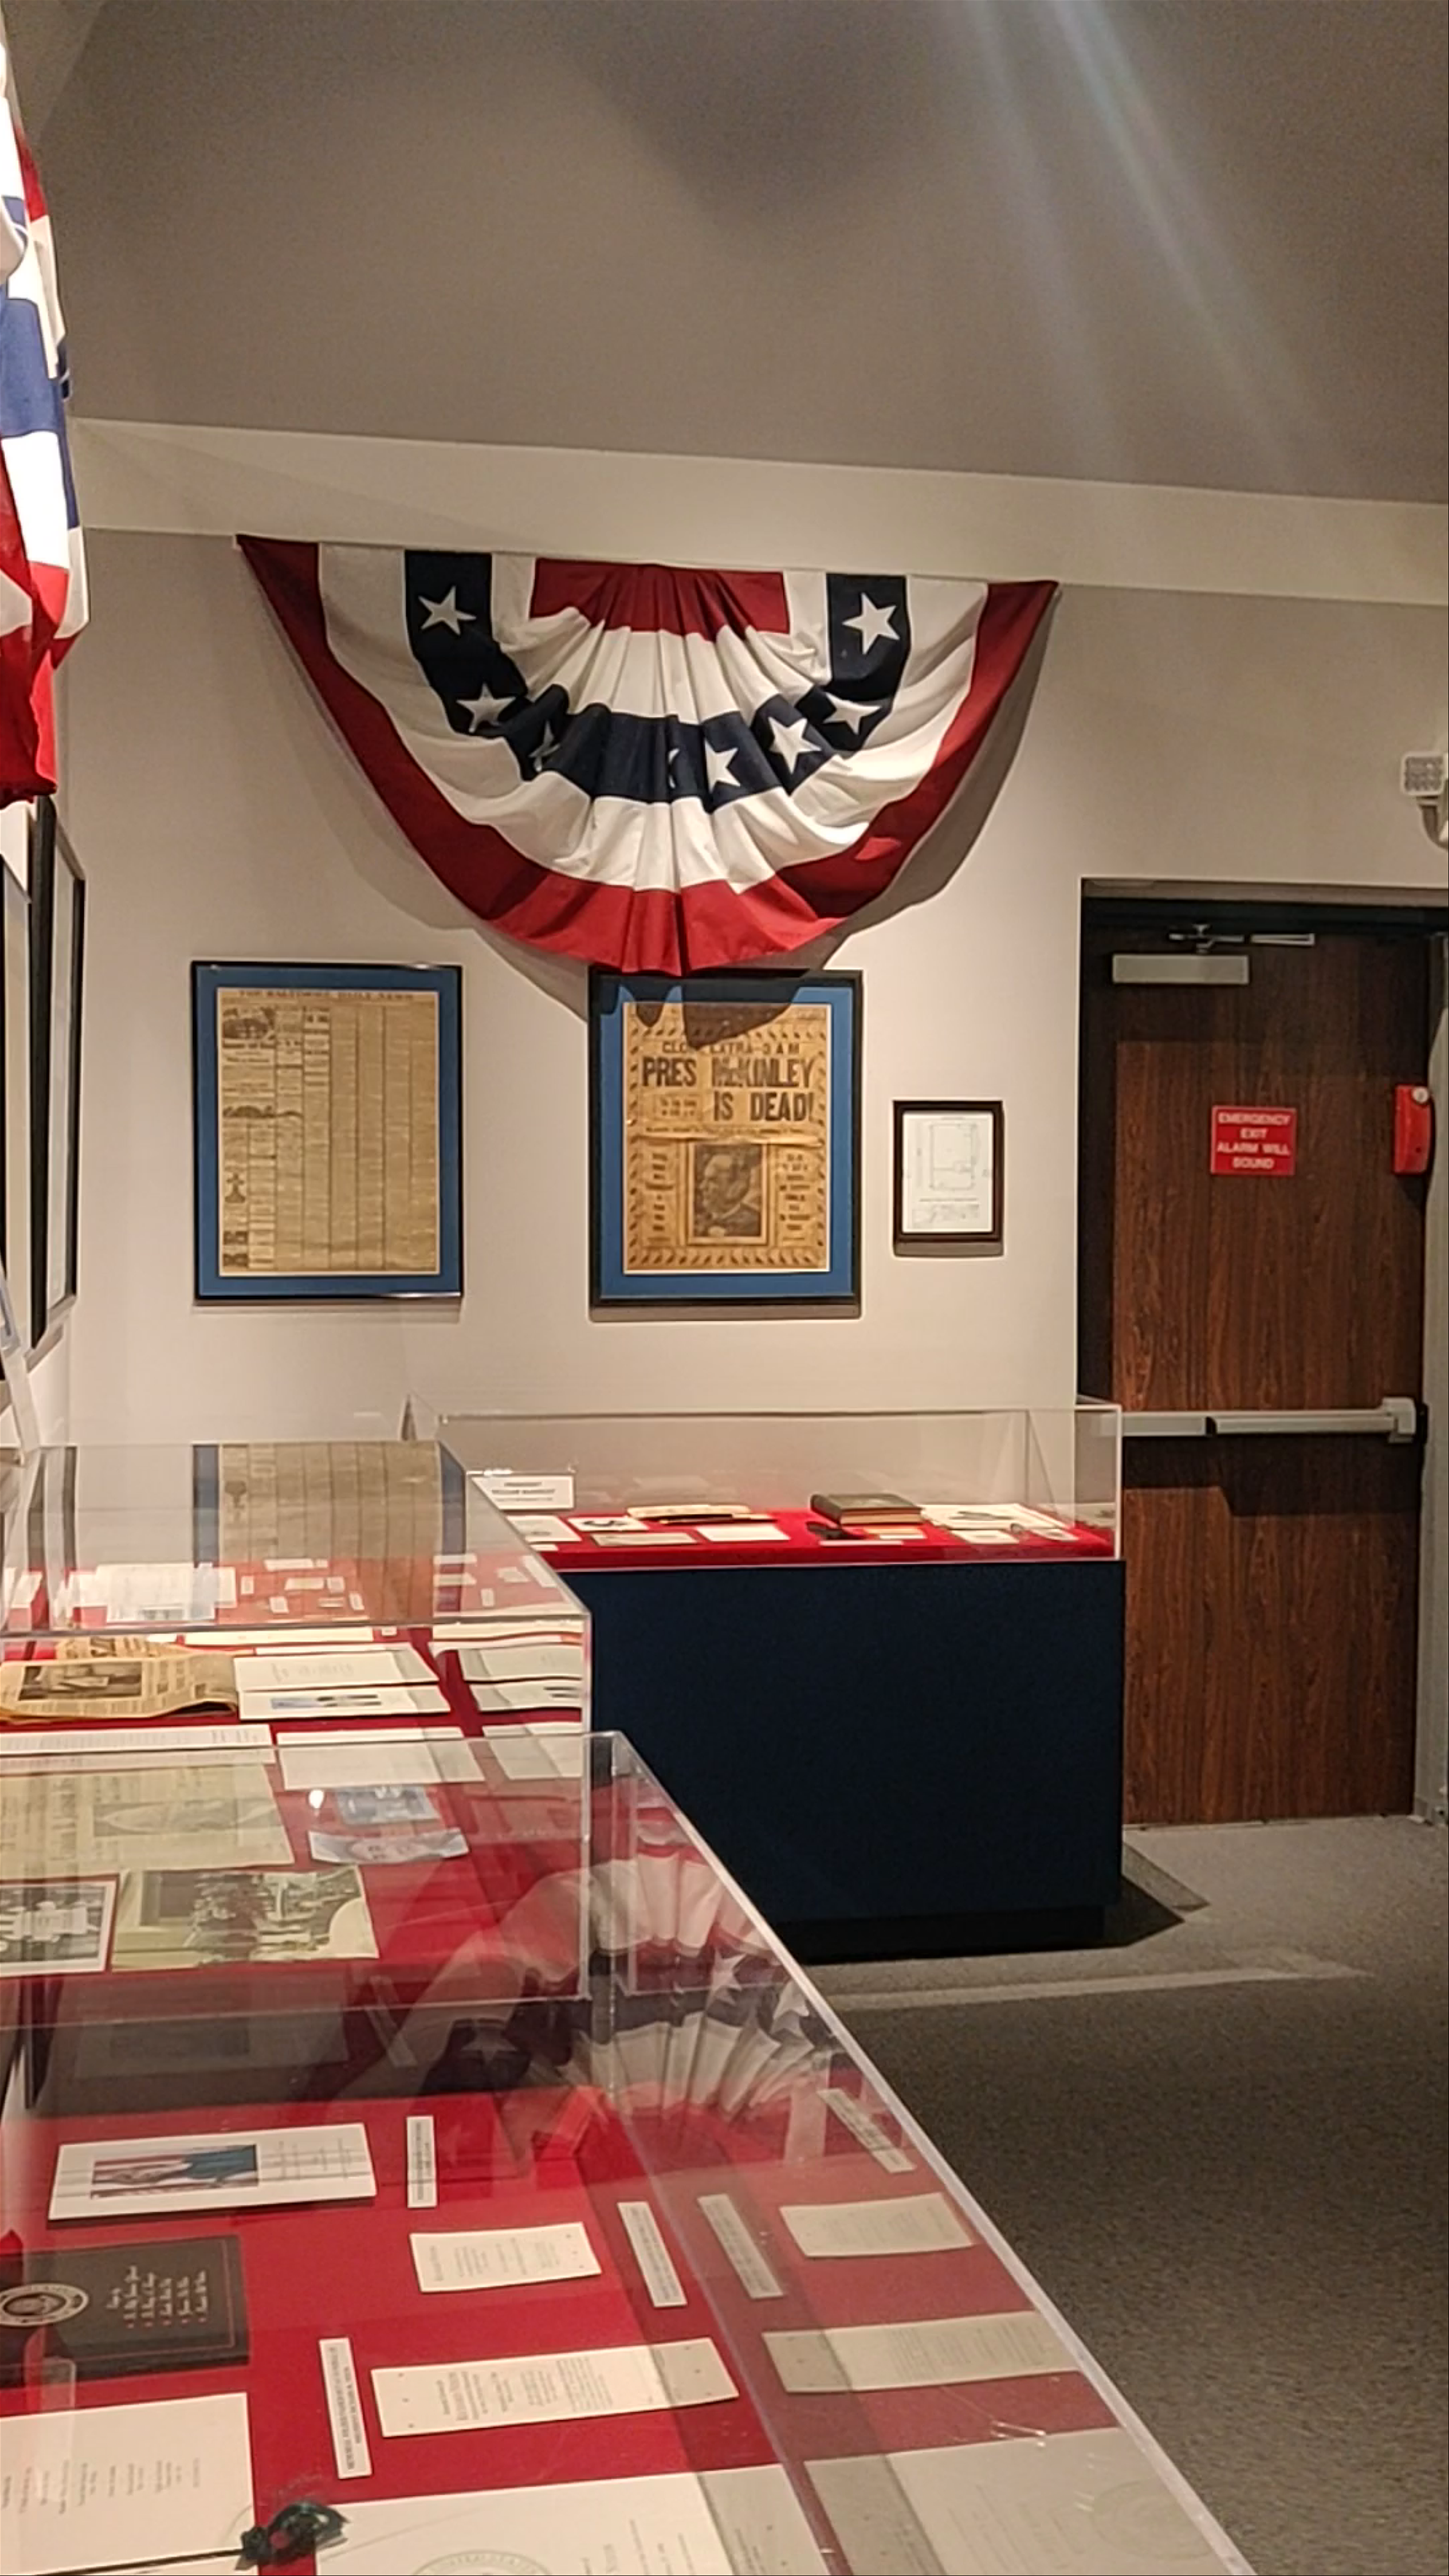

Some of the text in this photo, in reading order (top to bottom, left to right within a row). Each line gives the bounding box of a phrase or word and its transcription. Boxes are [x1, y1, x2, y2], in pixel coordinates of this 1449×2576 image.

[714, 1091, 734, 1121] IS
[750, 1092, 814, 1122] DEAD!
[1218, 1112, 1290, 1126] EMERGENCY
[1240, 1127, 1268, 1139] EXIT
[1217, 1141, 1291, 1156] ALARM WILL
[1233, 1157, 1275, 1169] SOUND
